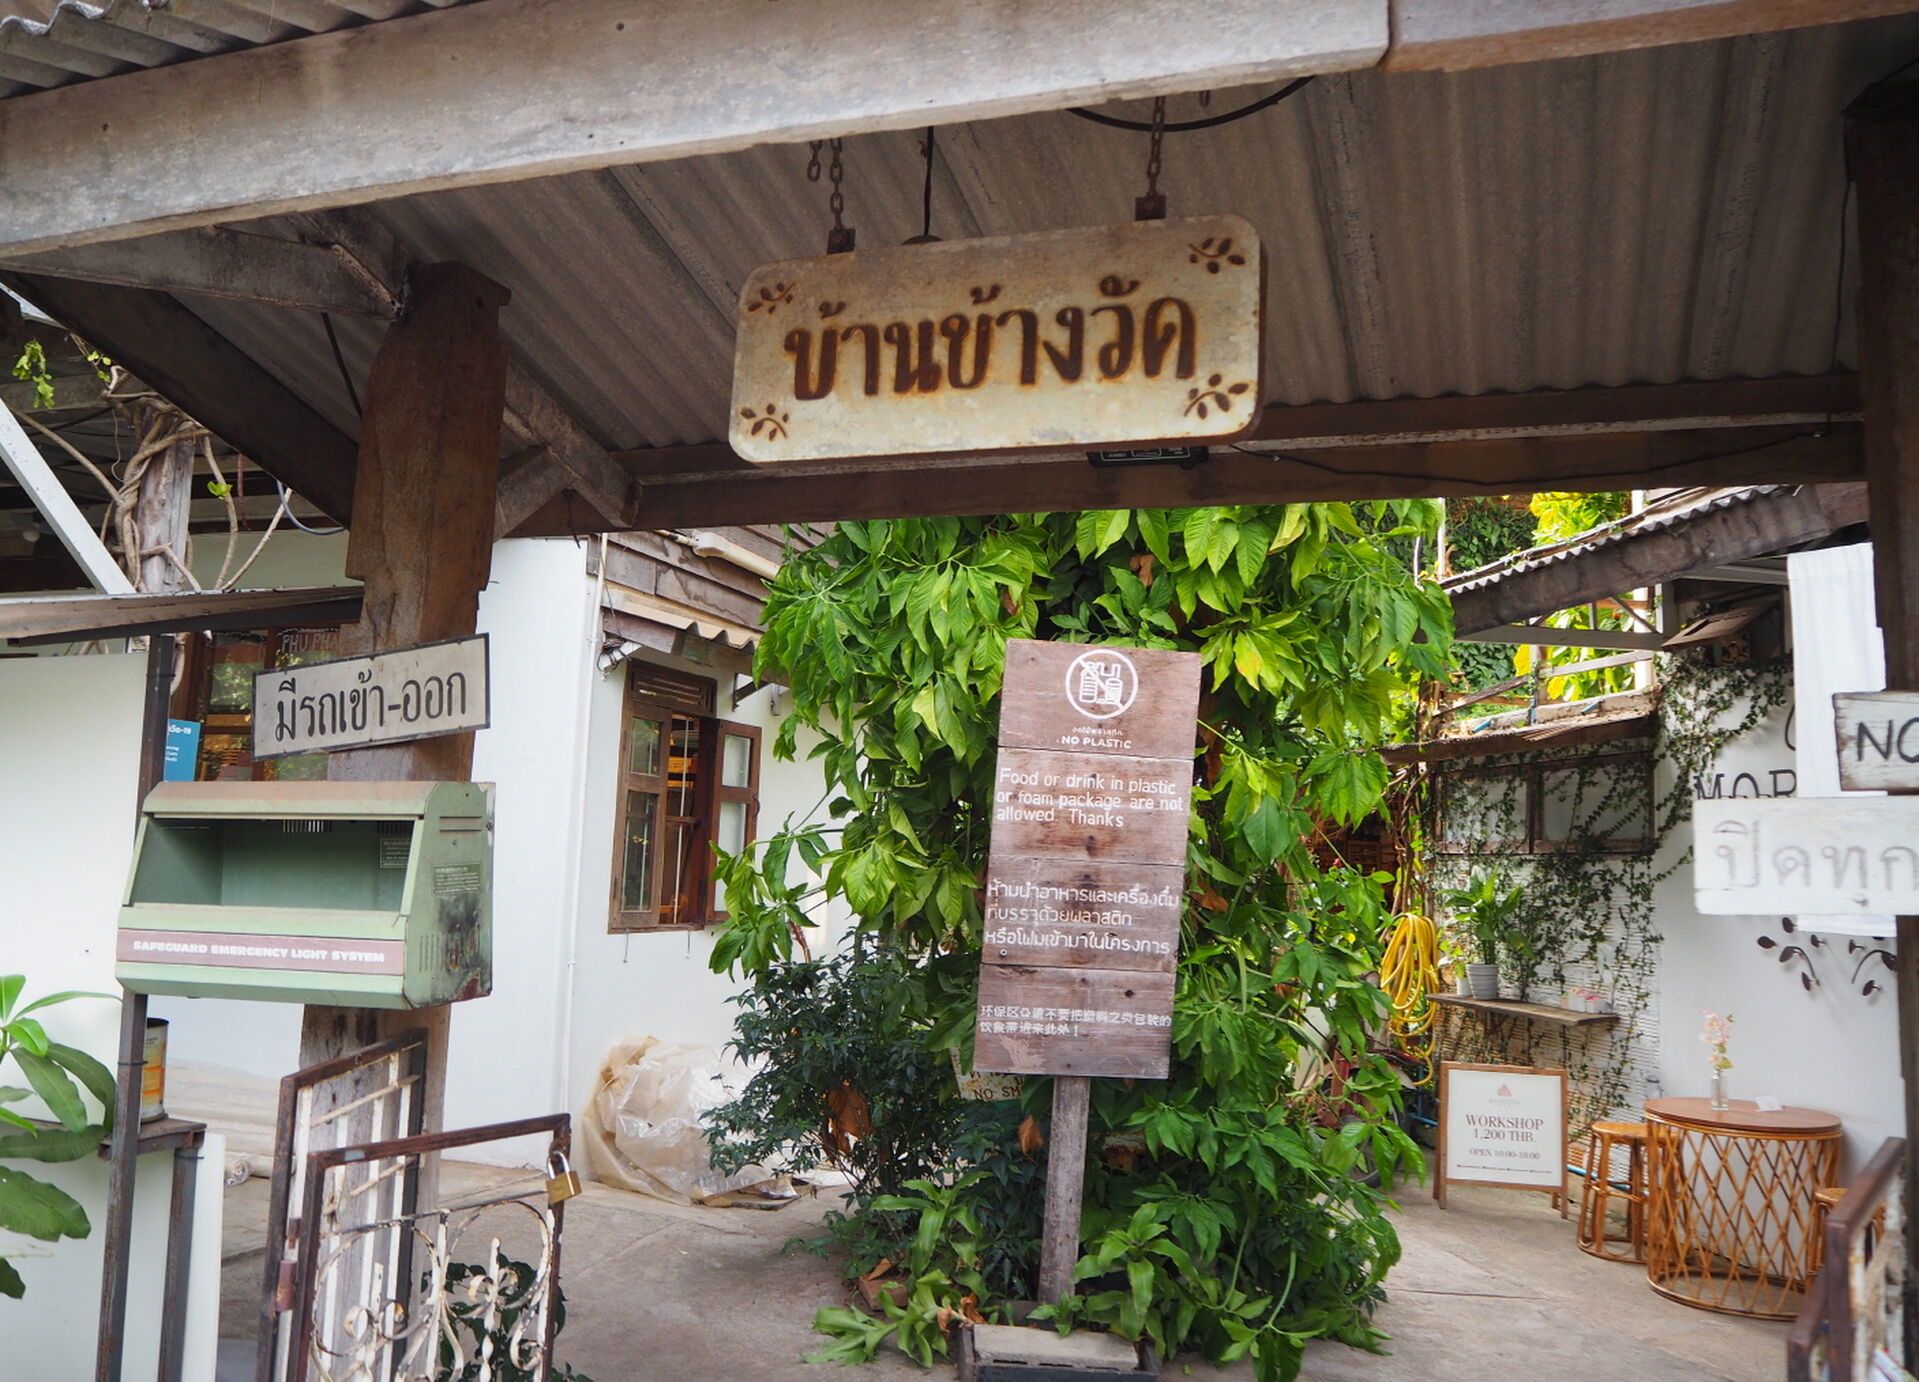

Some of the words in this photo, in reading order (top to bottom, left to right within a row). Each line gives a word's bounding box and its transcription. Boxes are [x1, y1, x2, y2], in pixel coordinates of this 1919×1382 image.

[784, 274, 1196, 400] บ้านข้างวัด
[275, 669, 467, 742] มีรถเข้า-ออก
[1061, 735, 1080, 745] NO
[1083, 737, 1132, 749] PLASTIC
[1000, 768, 1038, 786] Food
[1043, 775, 1060, 787] or
[1066, 774, 1104, 790] drink
[1110, 775, 1124, 790] in
[1128, 778, 1177, 795] plastic
[995, 790, 1013, 804] or
[1018, 791, 1054, 806] foam
[1058, 792, 1121, 811] package
[1129, 797, 1154, 810] are
[1159, 796, 1185, 812] not
[996, 806, 1058, 822] allowed.
[1069, 808, 1124, 828] Thanks
[987, 879, 1180, 908] ห้ามนำอาหารและเครื่องดื่ม
[987, 899, 1133, 927] ที่บรรจุด้วยพลาสติก
[133, 940, 208, 954] SAFEGUARD
[211, 944, 288, 958] EMERGENCY
[291, 948, 327, 960] LIGHT
[331, 950, 385, 963] SYSTEM
[984, 928, 1171, 954] หรือโฟมเข้ามาในโครงการ
[1466, 1114, 1544, 1130] WORKSHOP
[1469, 1147, 1492, 1157] OPEN
